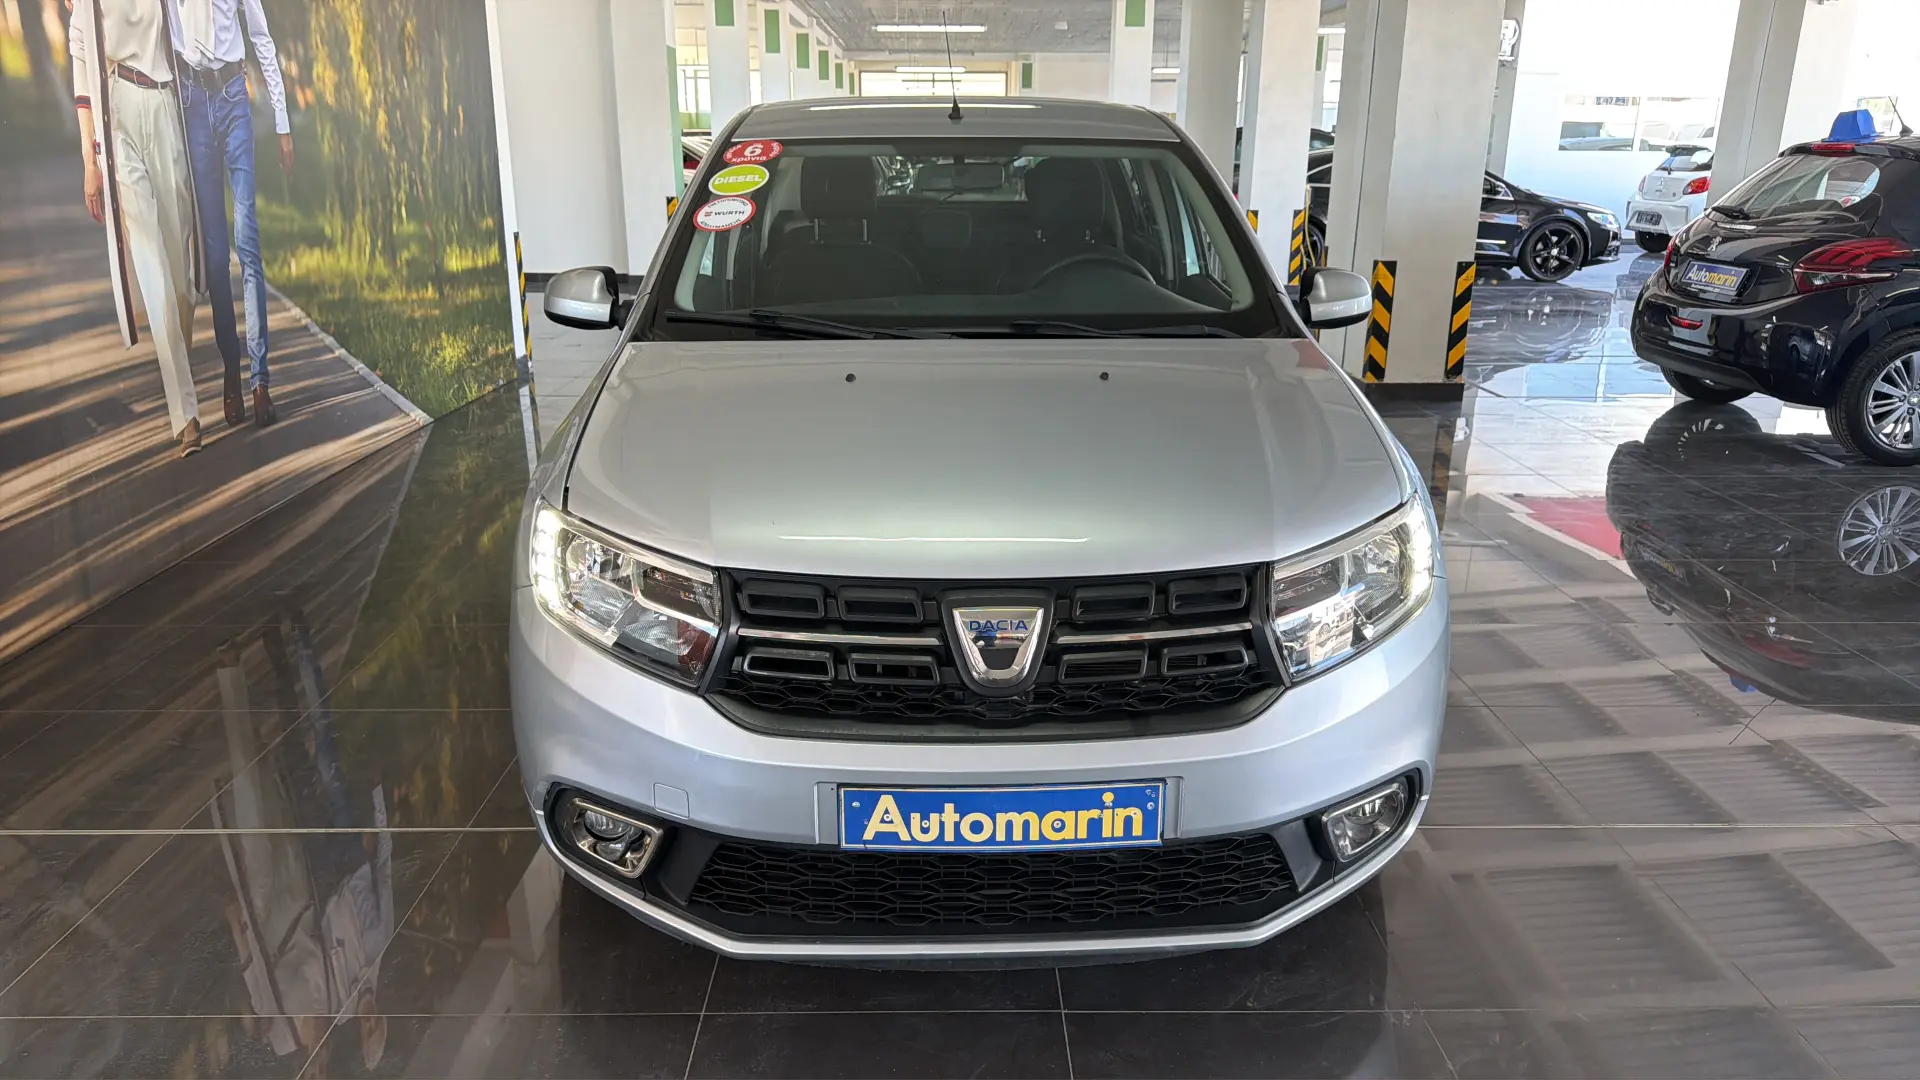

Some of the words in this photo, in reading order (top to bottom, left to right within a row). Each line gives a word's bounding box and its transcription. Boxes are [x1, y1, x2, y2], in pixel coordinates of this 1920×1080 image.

[744, 143, 764, 157] 6
[714, 174, 763, 185] DIESEL
[1686, 263, 1737, 287] Automarin
[969, 620, 1028, 631] DACIA
[862, 791, 1143, 843] Automarin
